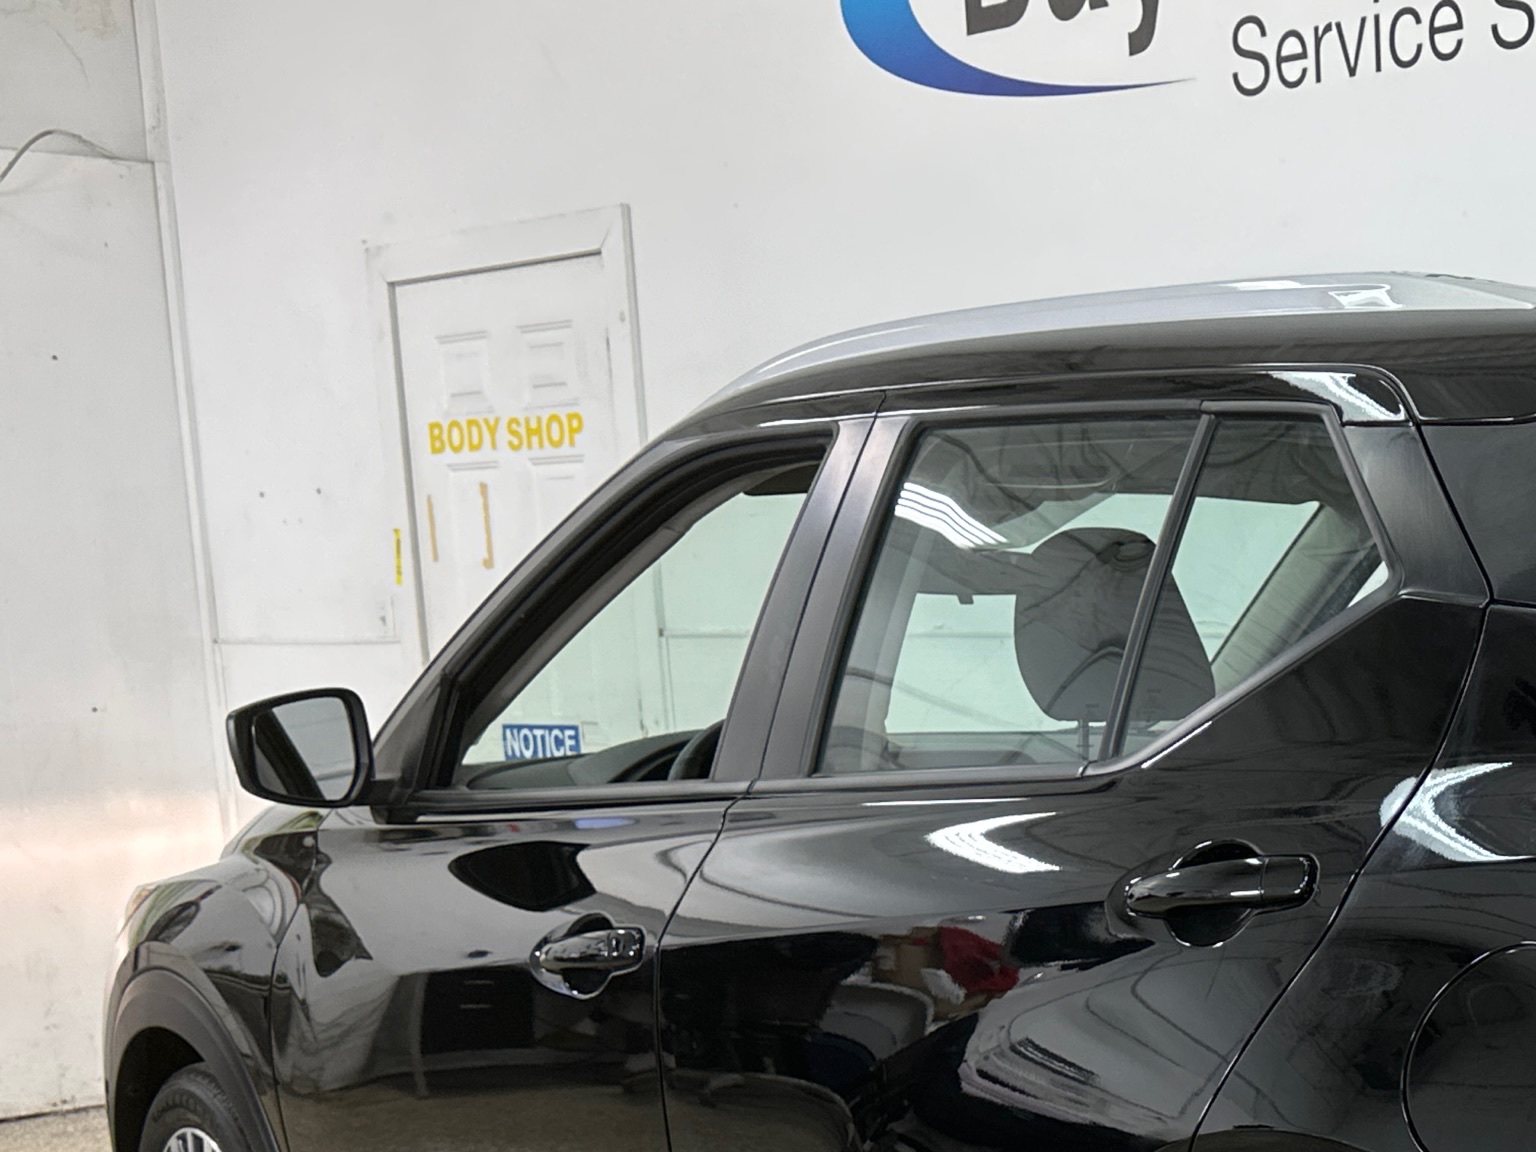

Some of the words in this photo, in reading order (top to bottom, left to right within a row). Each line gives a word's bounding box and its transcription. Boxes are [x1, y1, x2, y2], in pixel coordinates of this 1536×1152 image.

[1232, 0, 1464, 97] Service
[427, 416, 500, 455] BODY
[506, 412, 584, 451] SHOP
[505, 728, 577, 759] NOTICE
